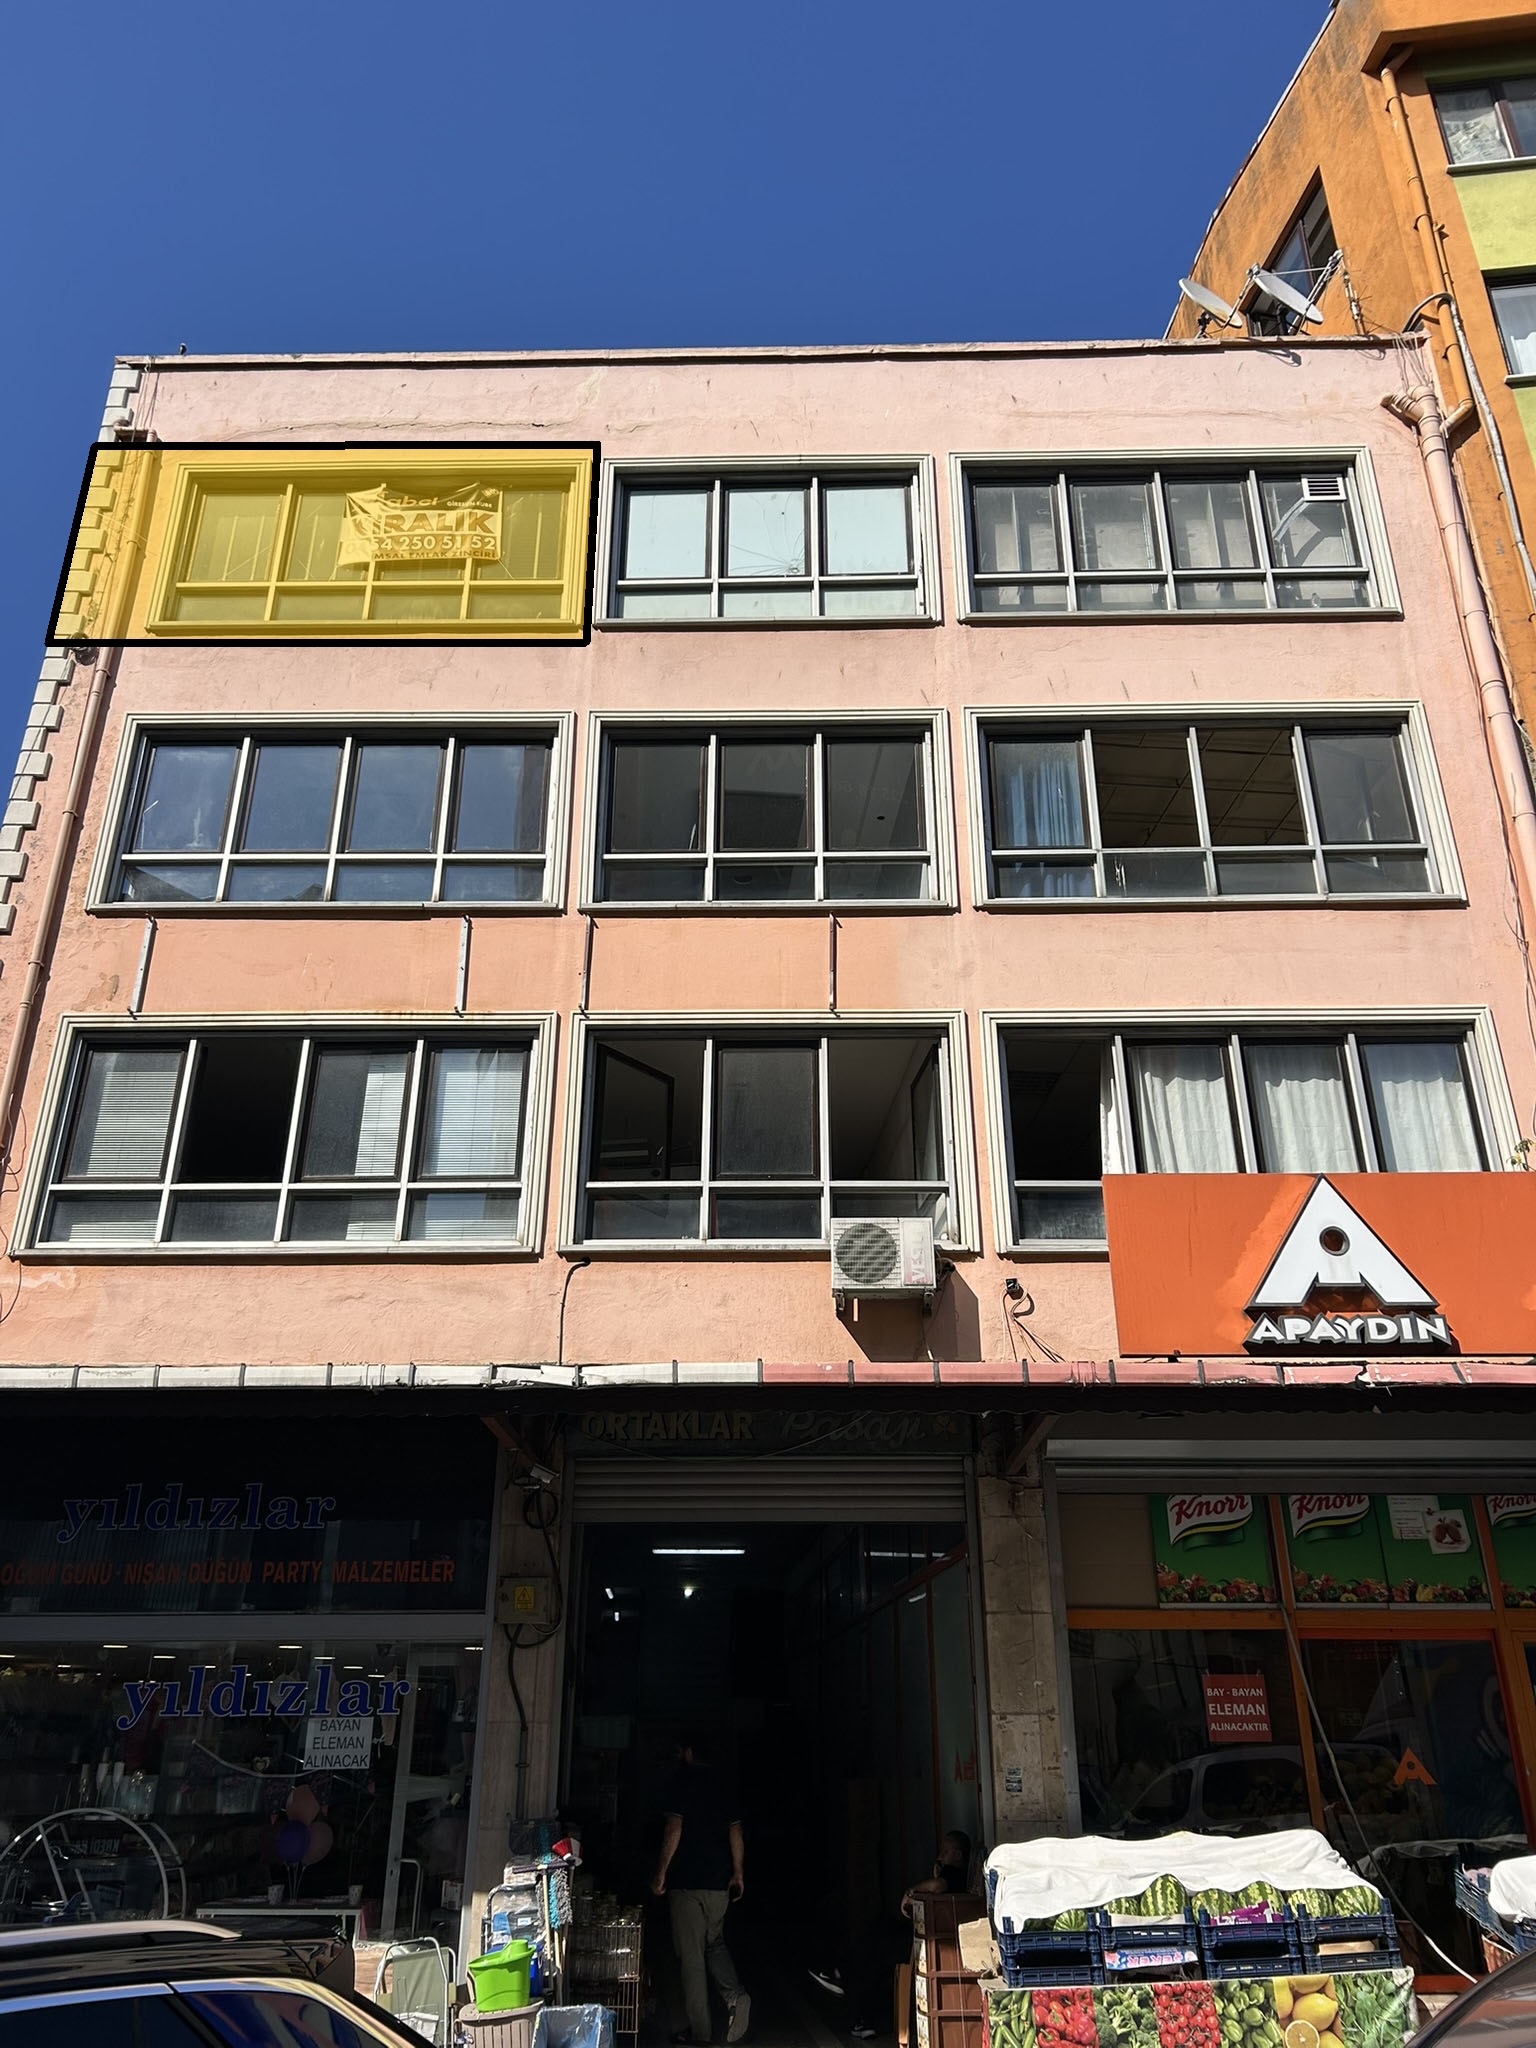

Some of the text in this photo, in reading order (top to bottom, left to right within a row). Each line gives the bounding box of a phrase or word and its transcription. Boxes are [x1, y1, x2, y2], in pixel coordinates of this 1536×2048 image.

[399, 535, 437, 550] 250
[441, 535, 462, 550] 51
[471, 535, 497, 550] 52
[373, 551, 404, 560] MSAL
[1246, 1312, 1452, 1347] APAYDIN
[580, 1411, 755, 1441] ORTAKLAR
[56, 1481, 337, 1544] yıldızlar
[1170, 1494, 1250, 1526] Knorr
[1292, 1494, 1367, 1520] Knorr
[260, 1560, 324, 1584] PARTY
[331, 1559, 457, 1584] MALZEMELER
[115, 1664, 412, 1731] yıldızlar
[1206, 1687, 1225, 1698] BAY
[1232, 1687, 1264, 1698] BAYAN
[1208, 1702, 1266, 1716] ELEMAN
[319, 1718, 362, 1733] BAYAN
[1210, 1721, 1269, 1732] ALINACAKTIR
[312, 1737, 365, 1751] ELEMAN
[304, 1754, 369, 1769] ALINACAK
